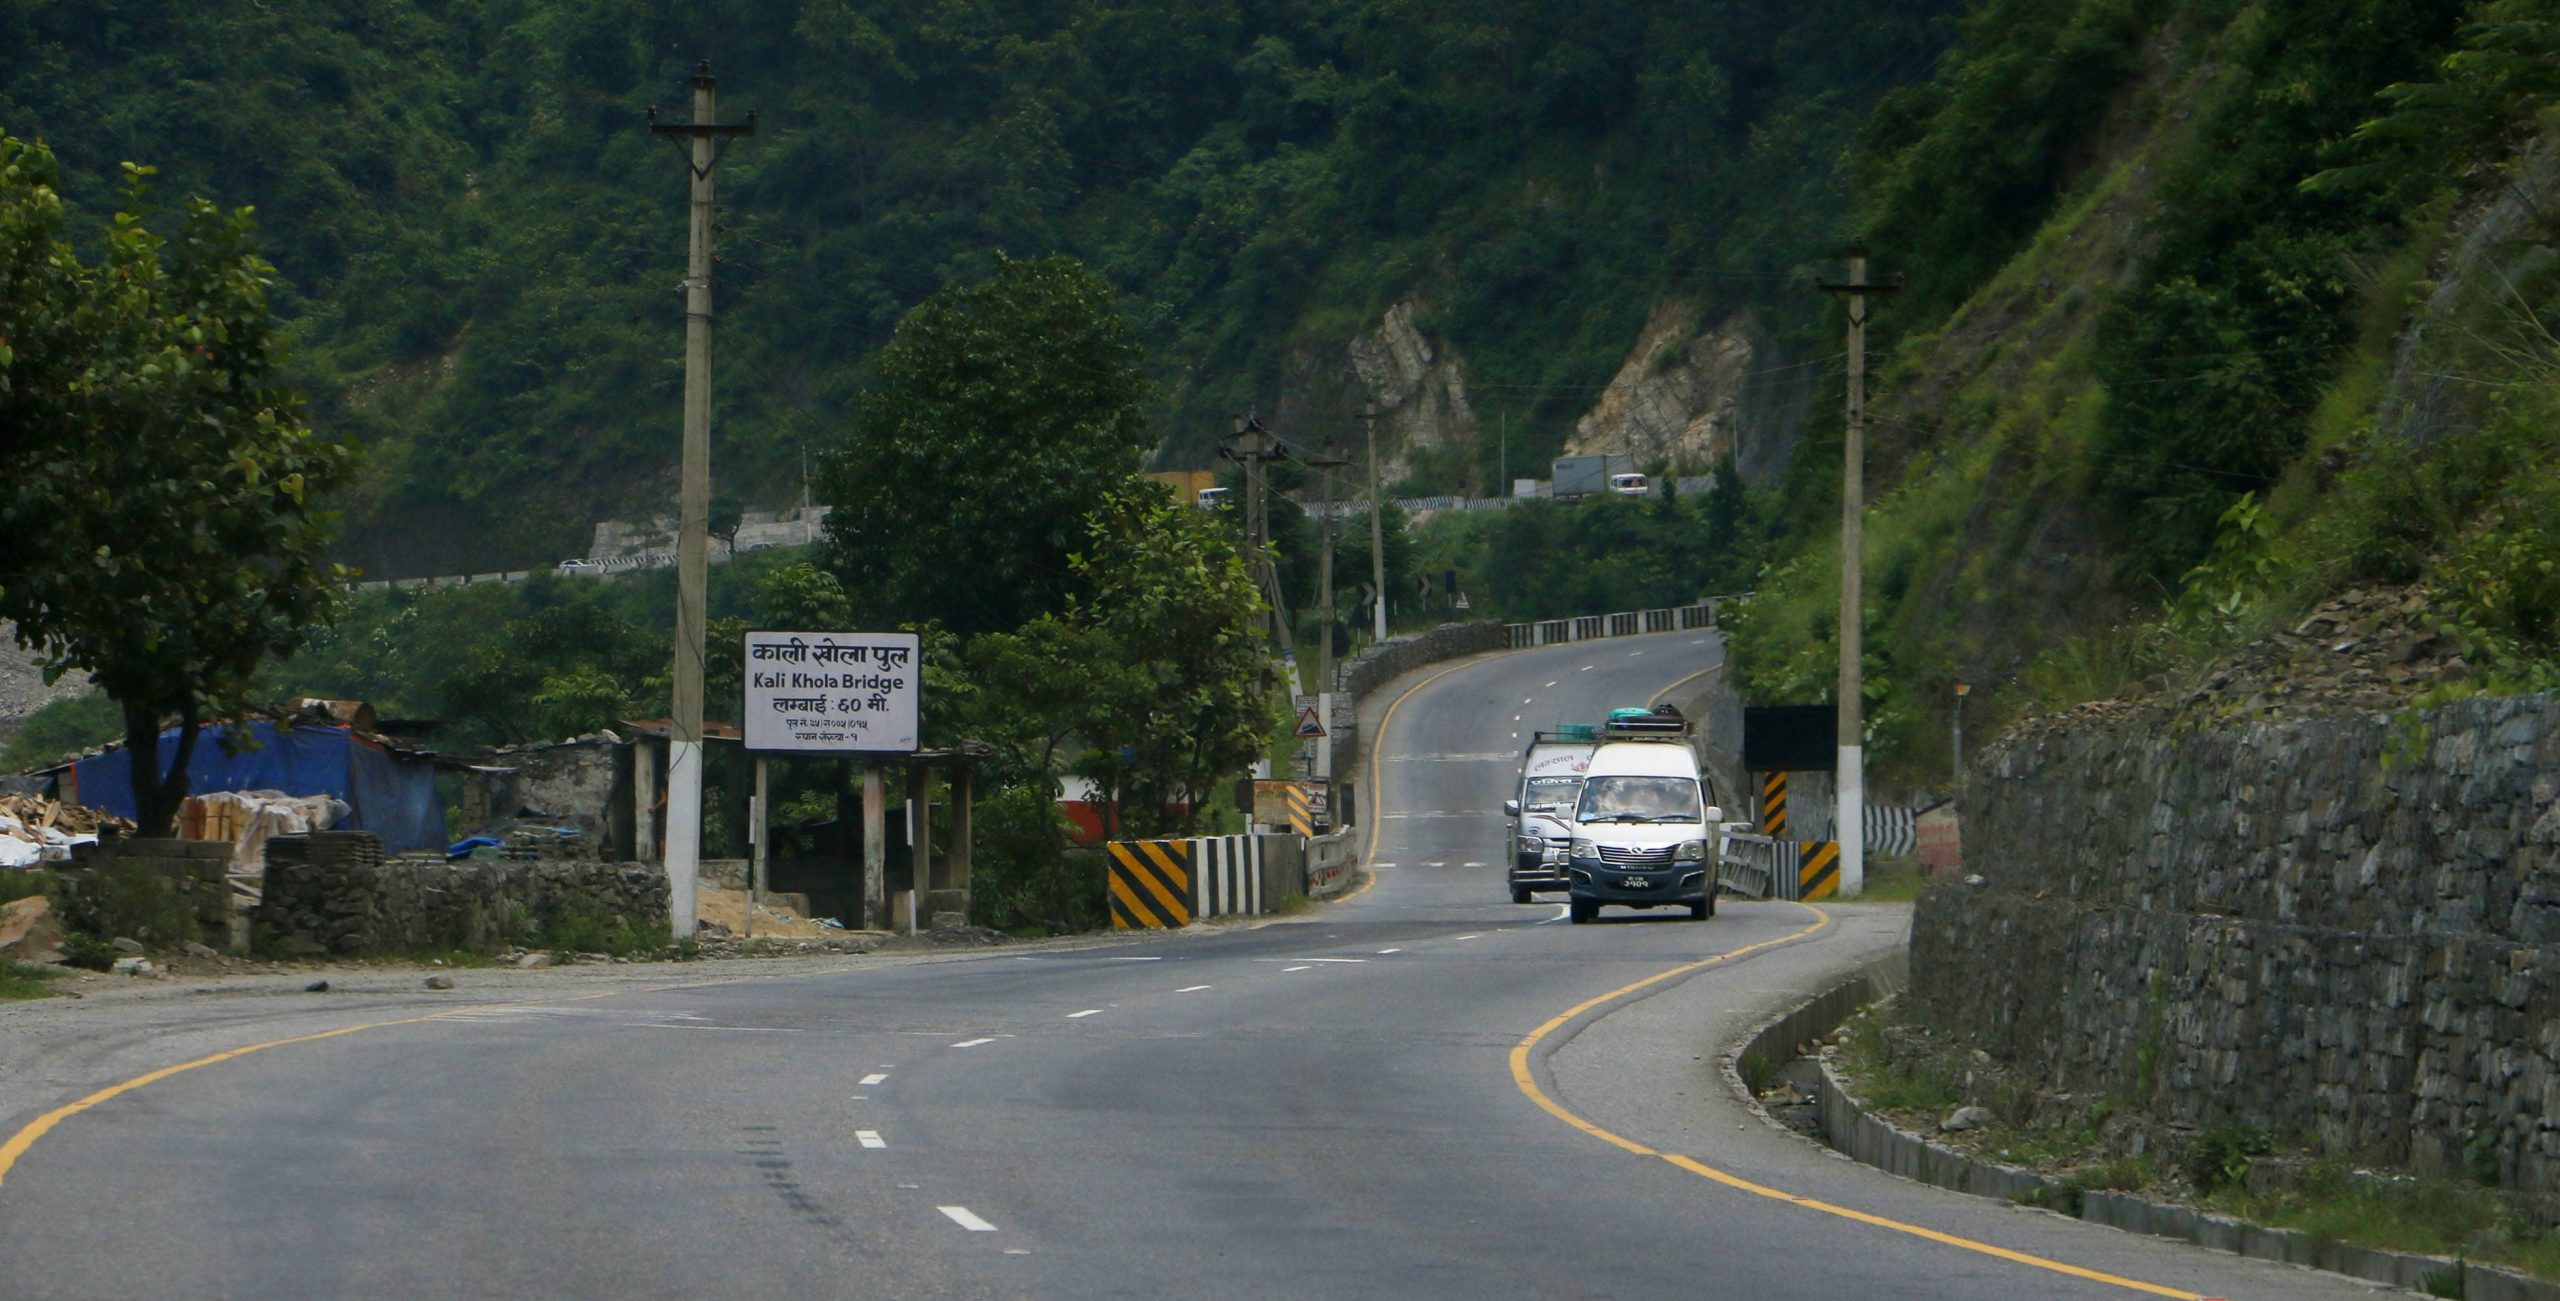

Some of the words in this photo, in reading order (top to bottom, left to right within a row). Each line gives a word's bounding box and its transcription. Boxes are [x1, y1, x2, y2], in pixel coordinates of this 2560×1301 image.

[752, 637, 809, 665] काली
[812, 638, 868, 667] खोला
[871, 646, 910, 672] पुल
[754, 672, 786, 688] Kali
[792, 673, 838, 689] Khola
[842, 674, 904, 694] Bridge
[773, 694, 826, 715] लम्बाई
[837, 698, 861, 713] ६०
[786, 719, 798, 730] पुल
